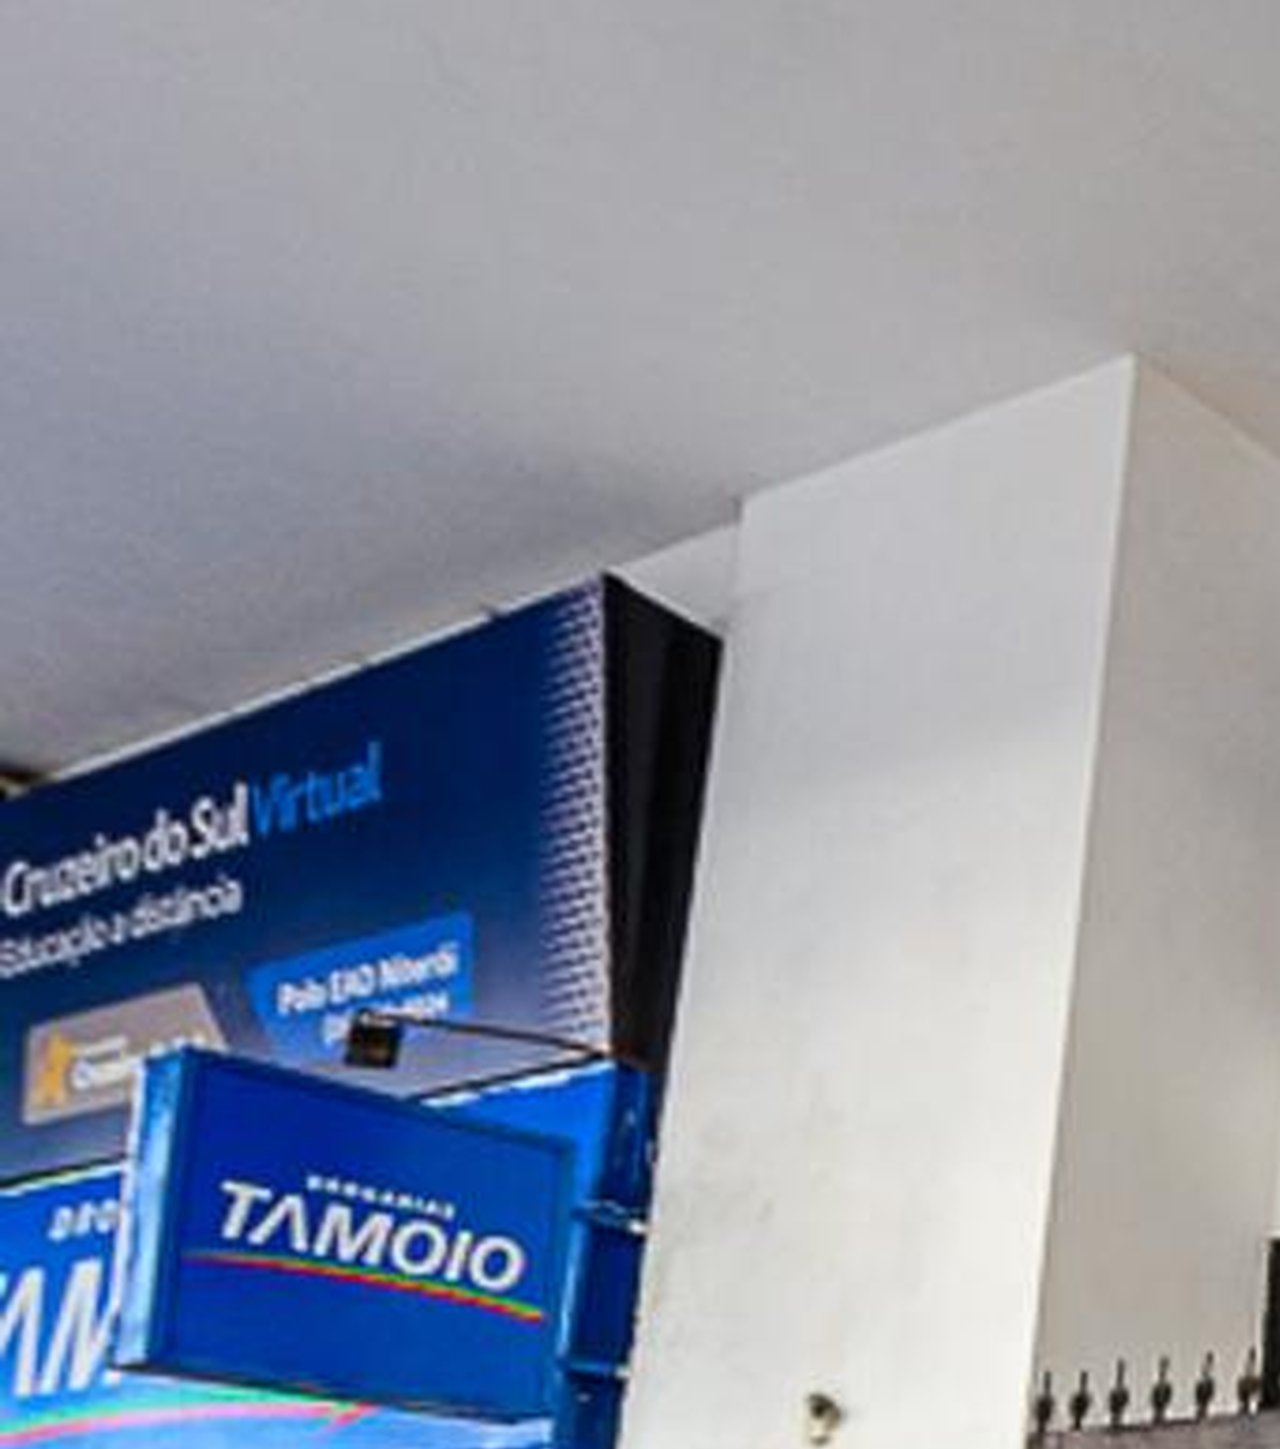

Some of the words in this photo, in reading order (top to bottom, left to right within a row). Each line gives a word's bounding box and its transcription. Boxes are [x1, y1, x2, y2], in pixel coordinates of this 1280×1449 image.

[4, 832, 140, 918] Cruzeiro
[143, 806, 189, 872] do
[191, 781, 250, 859] Sul
[252, 740, 383, 835] Virtual
[219, 1180, 526, 1292] TAMOIO
